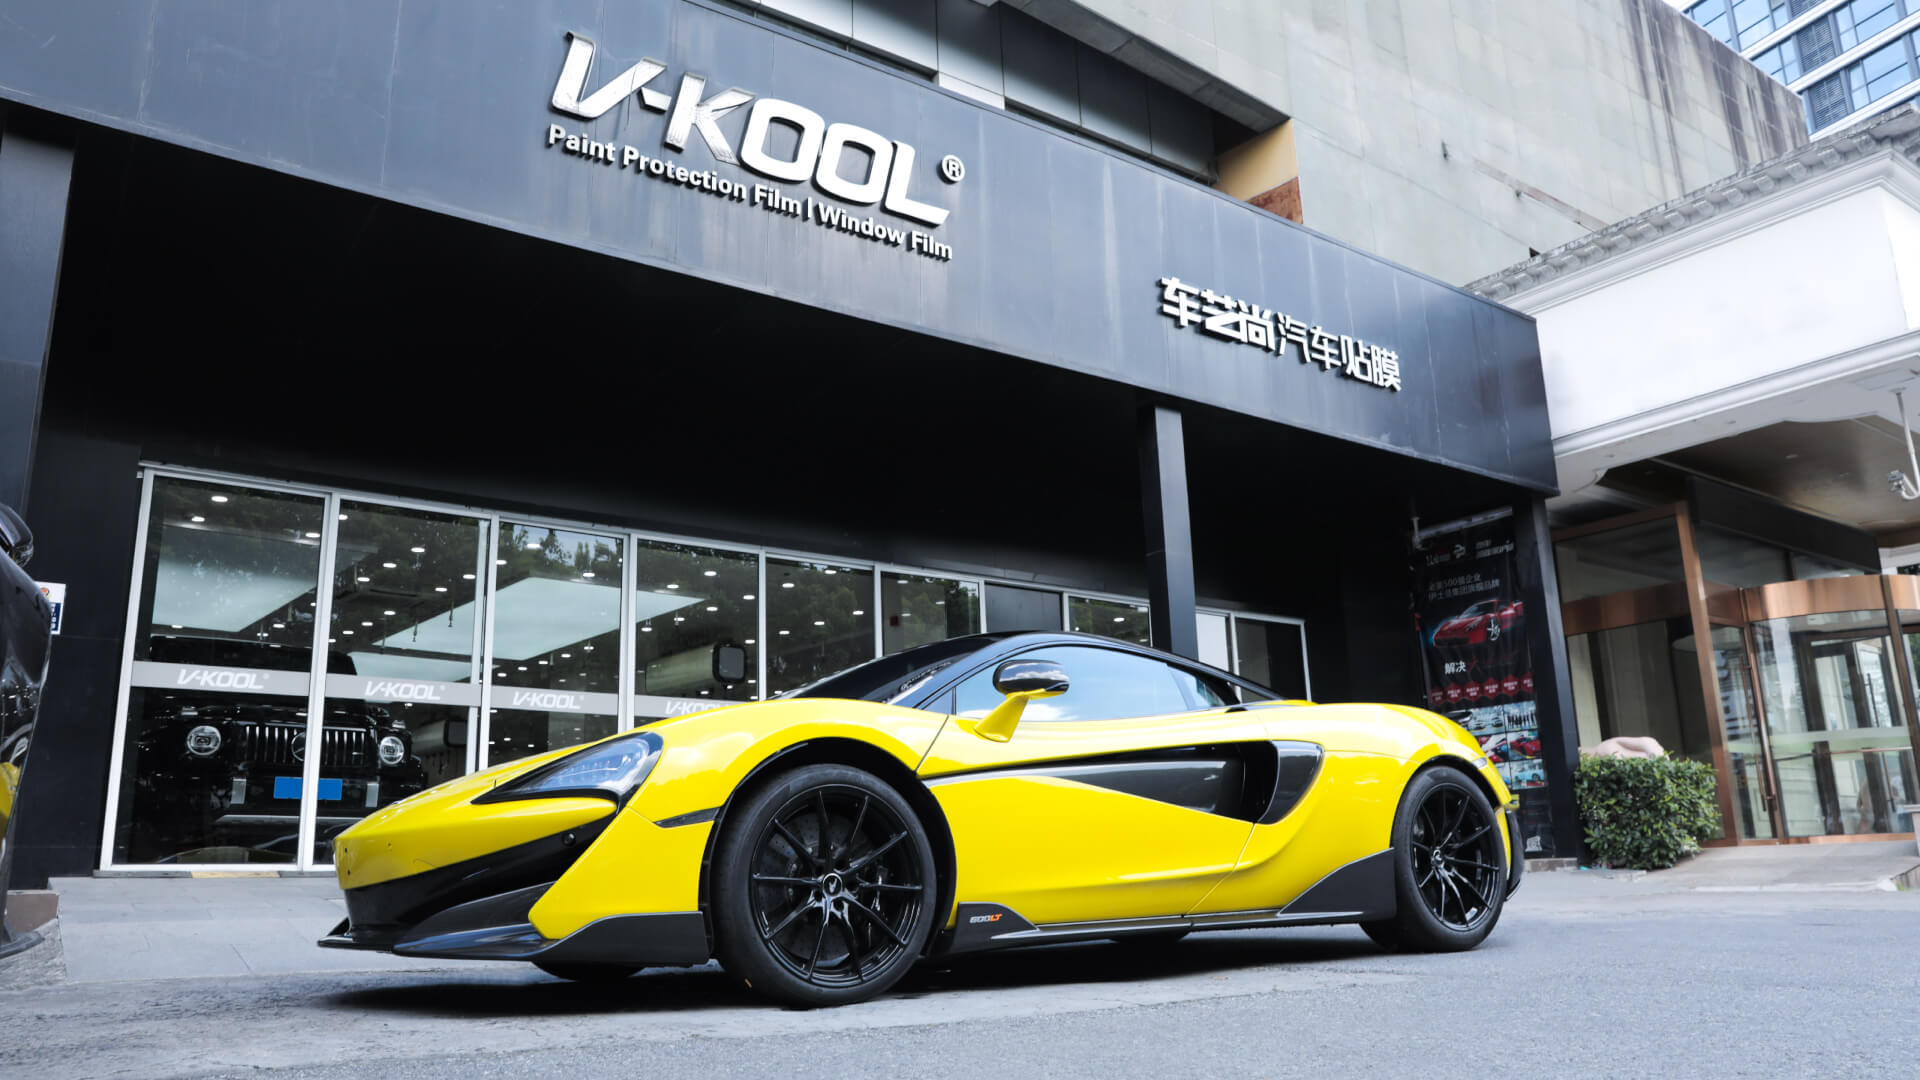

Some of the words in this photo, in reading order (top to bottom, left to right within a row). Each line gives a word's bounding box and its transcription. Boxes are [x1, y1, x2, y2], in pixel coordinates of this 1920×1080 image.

[548, 123, 616, 162] Paint
[622, 144, 747, 201] Protection
[754, 184, 802, 217] Film
[818, 201, 907, 246] Window
[911, 230, 954, 261] Film
